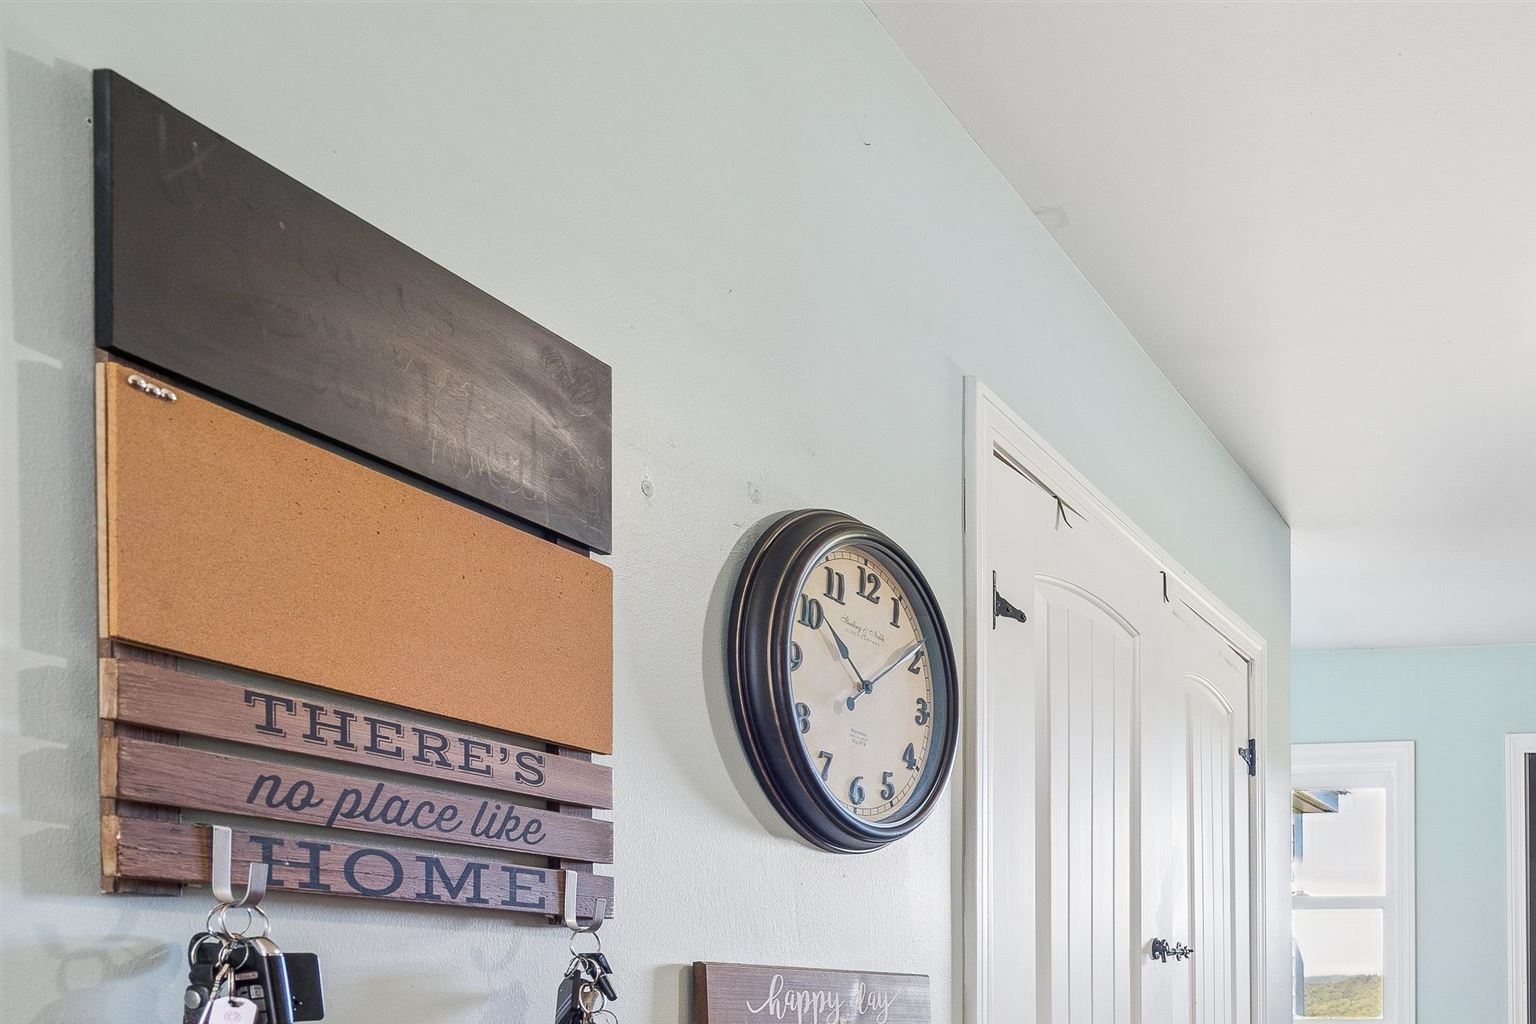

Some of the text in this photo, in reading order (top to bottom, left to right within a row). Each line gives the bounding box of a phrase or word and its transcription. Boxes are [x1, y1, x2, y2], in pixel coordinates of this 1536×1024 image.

[823, 566, 846, 606] 11
[856, 566, 881, 605] 12
[797, 593, 825, 630] 10
[890, 596, 901, 629] 1
[790, 640, 803, 672] 9
[907, 648, 921, 675] 2
[795, 702, 811, 735] 8
[914, 697, 928, 726] 3
[244, 689, 547, 788] THERE'S
[818, 750, 834, 781] 7
[902, 742, 917, 771] 4
[848, 776, 866, 806] 6
[880, 771, 896, 801] 5
[246, 773, 547, 846] no place like
[249, 835, 548, 910] HOME
[855, 982, 899, 1024] day
